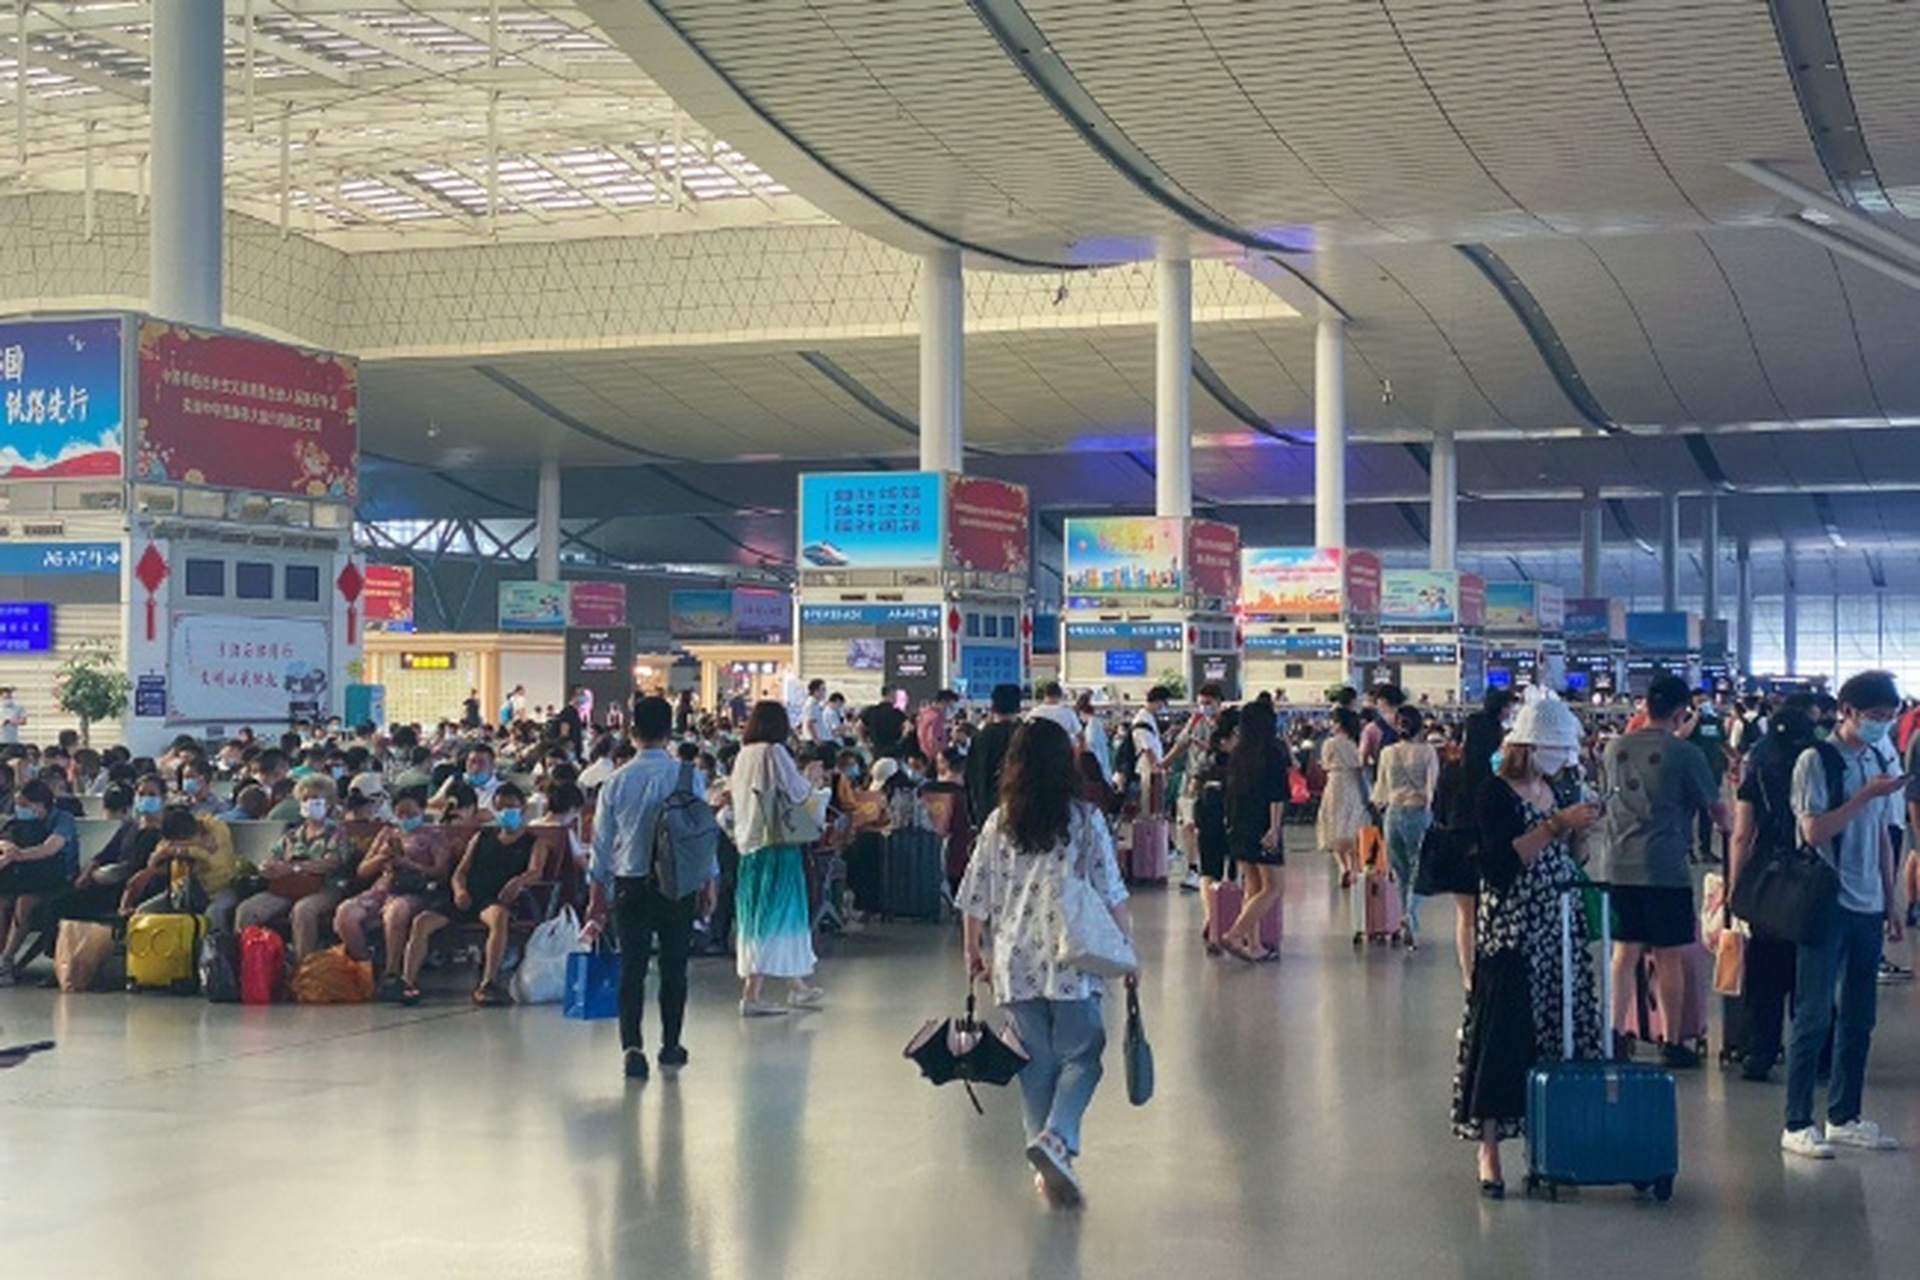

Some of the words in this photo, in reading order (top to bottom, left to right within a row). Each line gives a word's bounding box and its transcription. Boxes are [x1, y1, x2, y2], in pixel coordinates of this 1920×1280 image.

[0, 345, 24, 383] 国
[6, 385, 88, 424] 铁路先行
